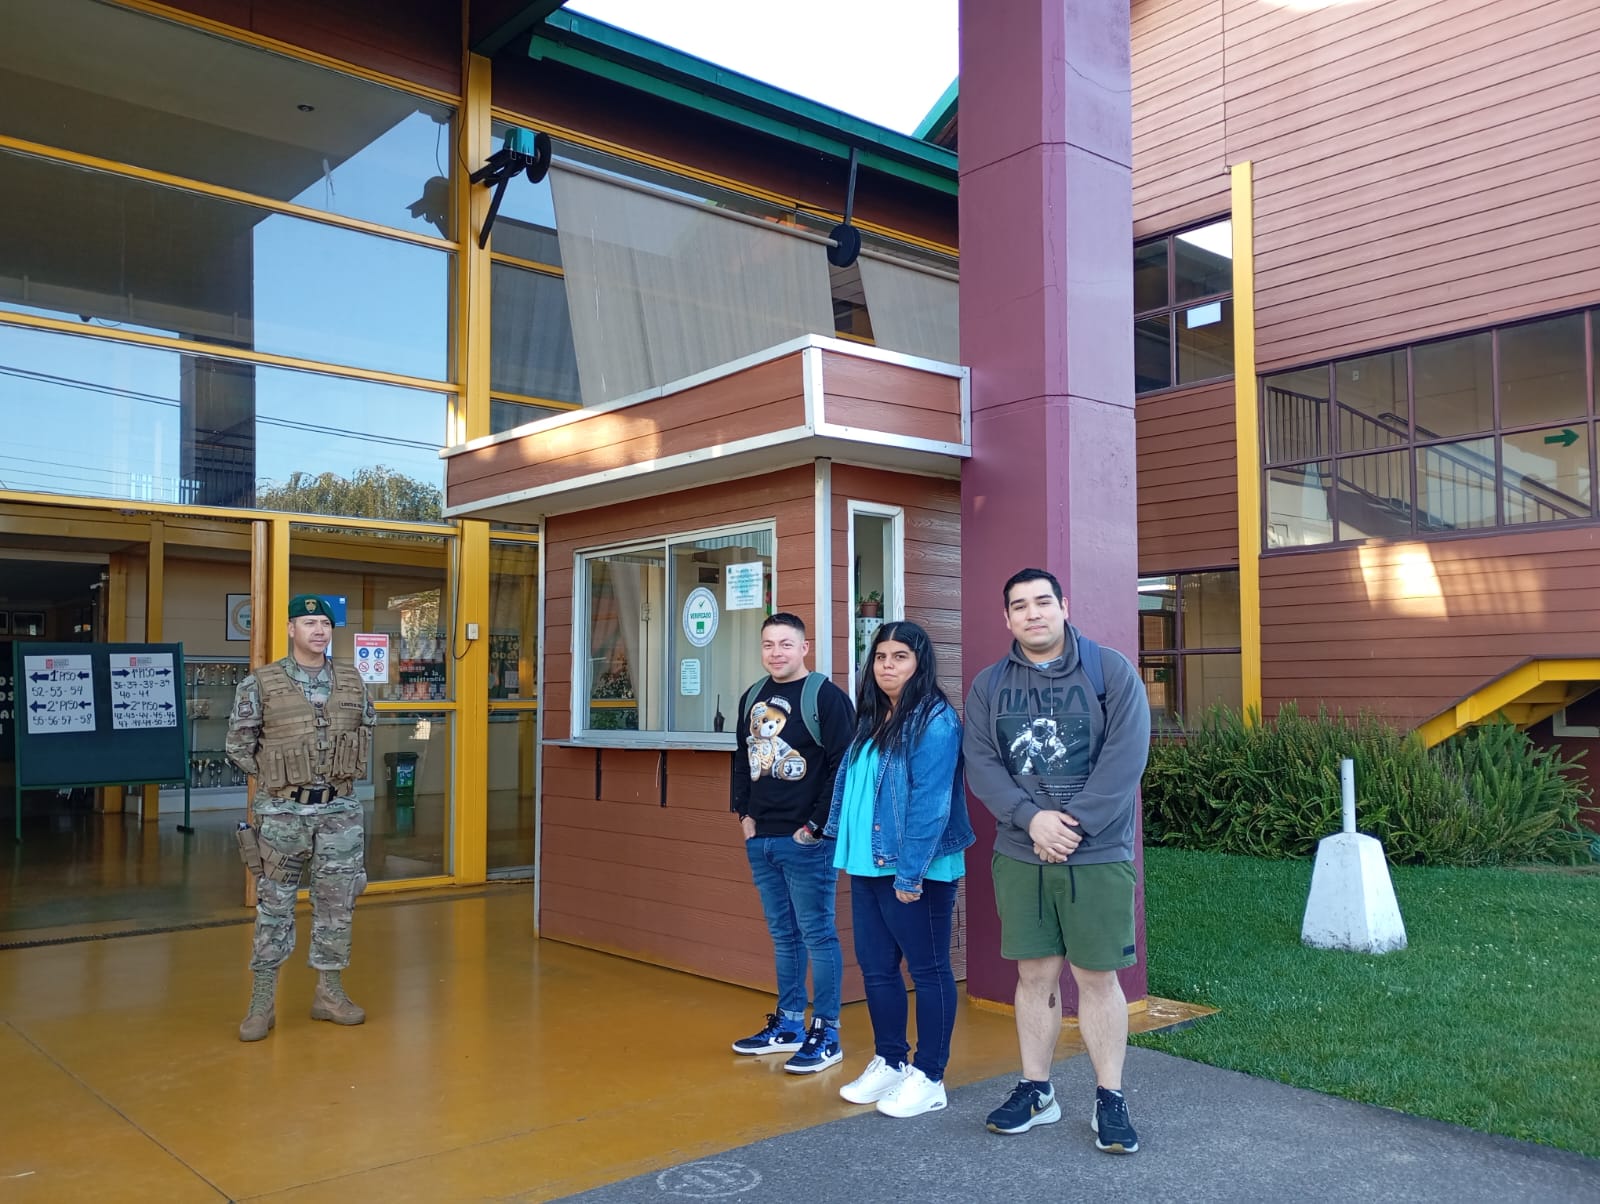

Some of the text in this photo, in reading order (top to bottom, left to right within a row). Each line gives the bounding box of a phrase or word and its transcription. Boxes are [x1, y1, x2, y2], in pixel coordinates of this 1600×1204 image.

[59, 671, 76, 681] PISO
[998, 685, 1090, 714] NASA
[59, 700, 78, 711] PISO
